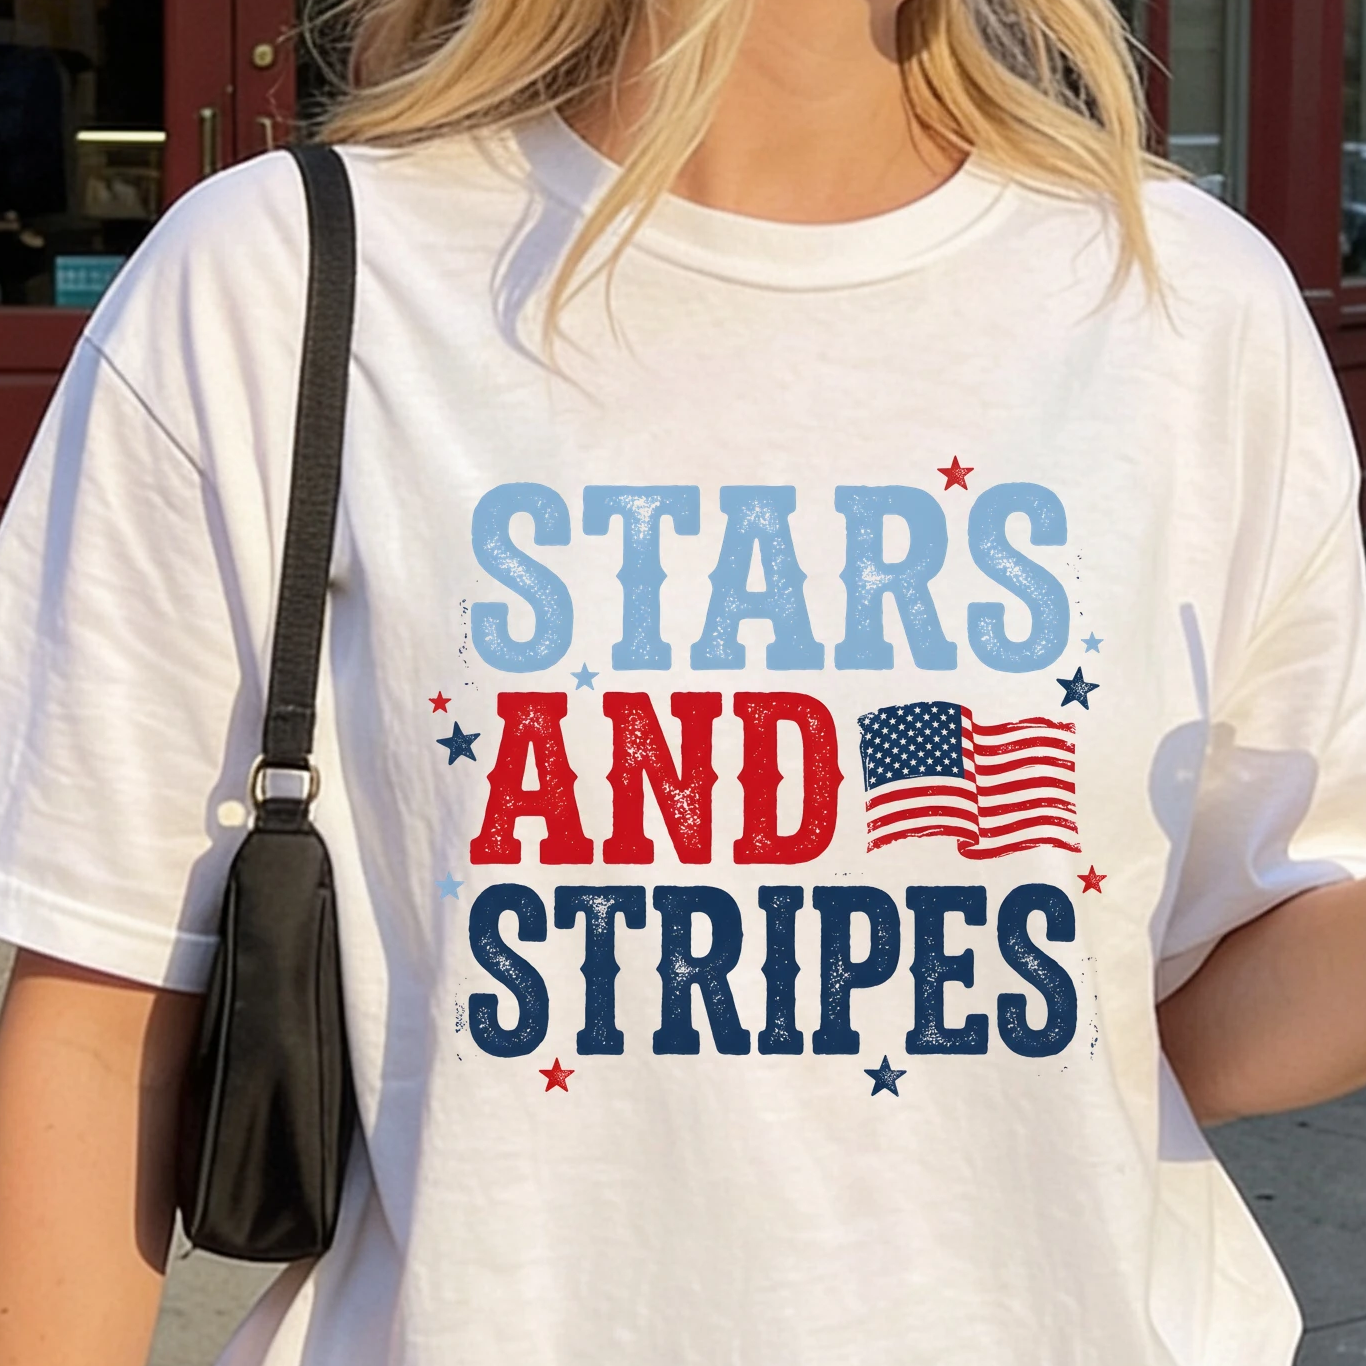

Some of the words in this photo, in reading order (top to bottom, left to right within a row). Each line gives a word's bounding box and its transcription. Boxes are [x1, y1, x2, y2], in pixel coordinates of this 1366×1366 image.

[472, 484, 1068, 672] STARS
[469, 691, 844, 865] AND
[469, 884, 1077, 1057] STRIPES
